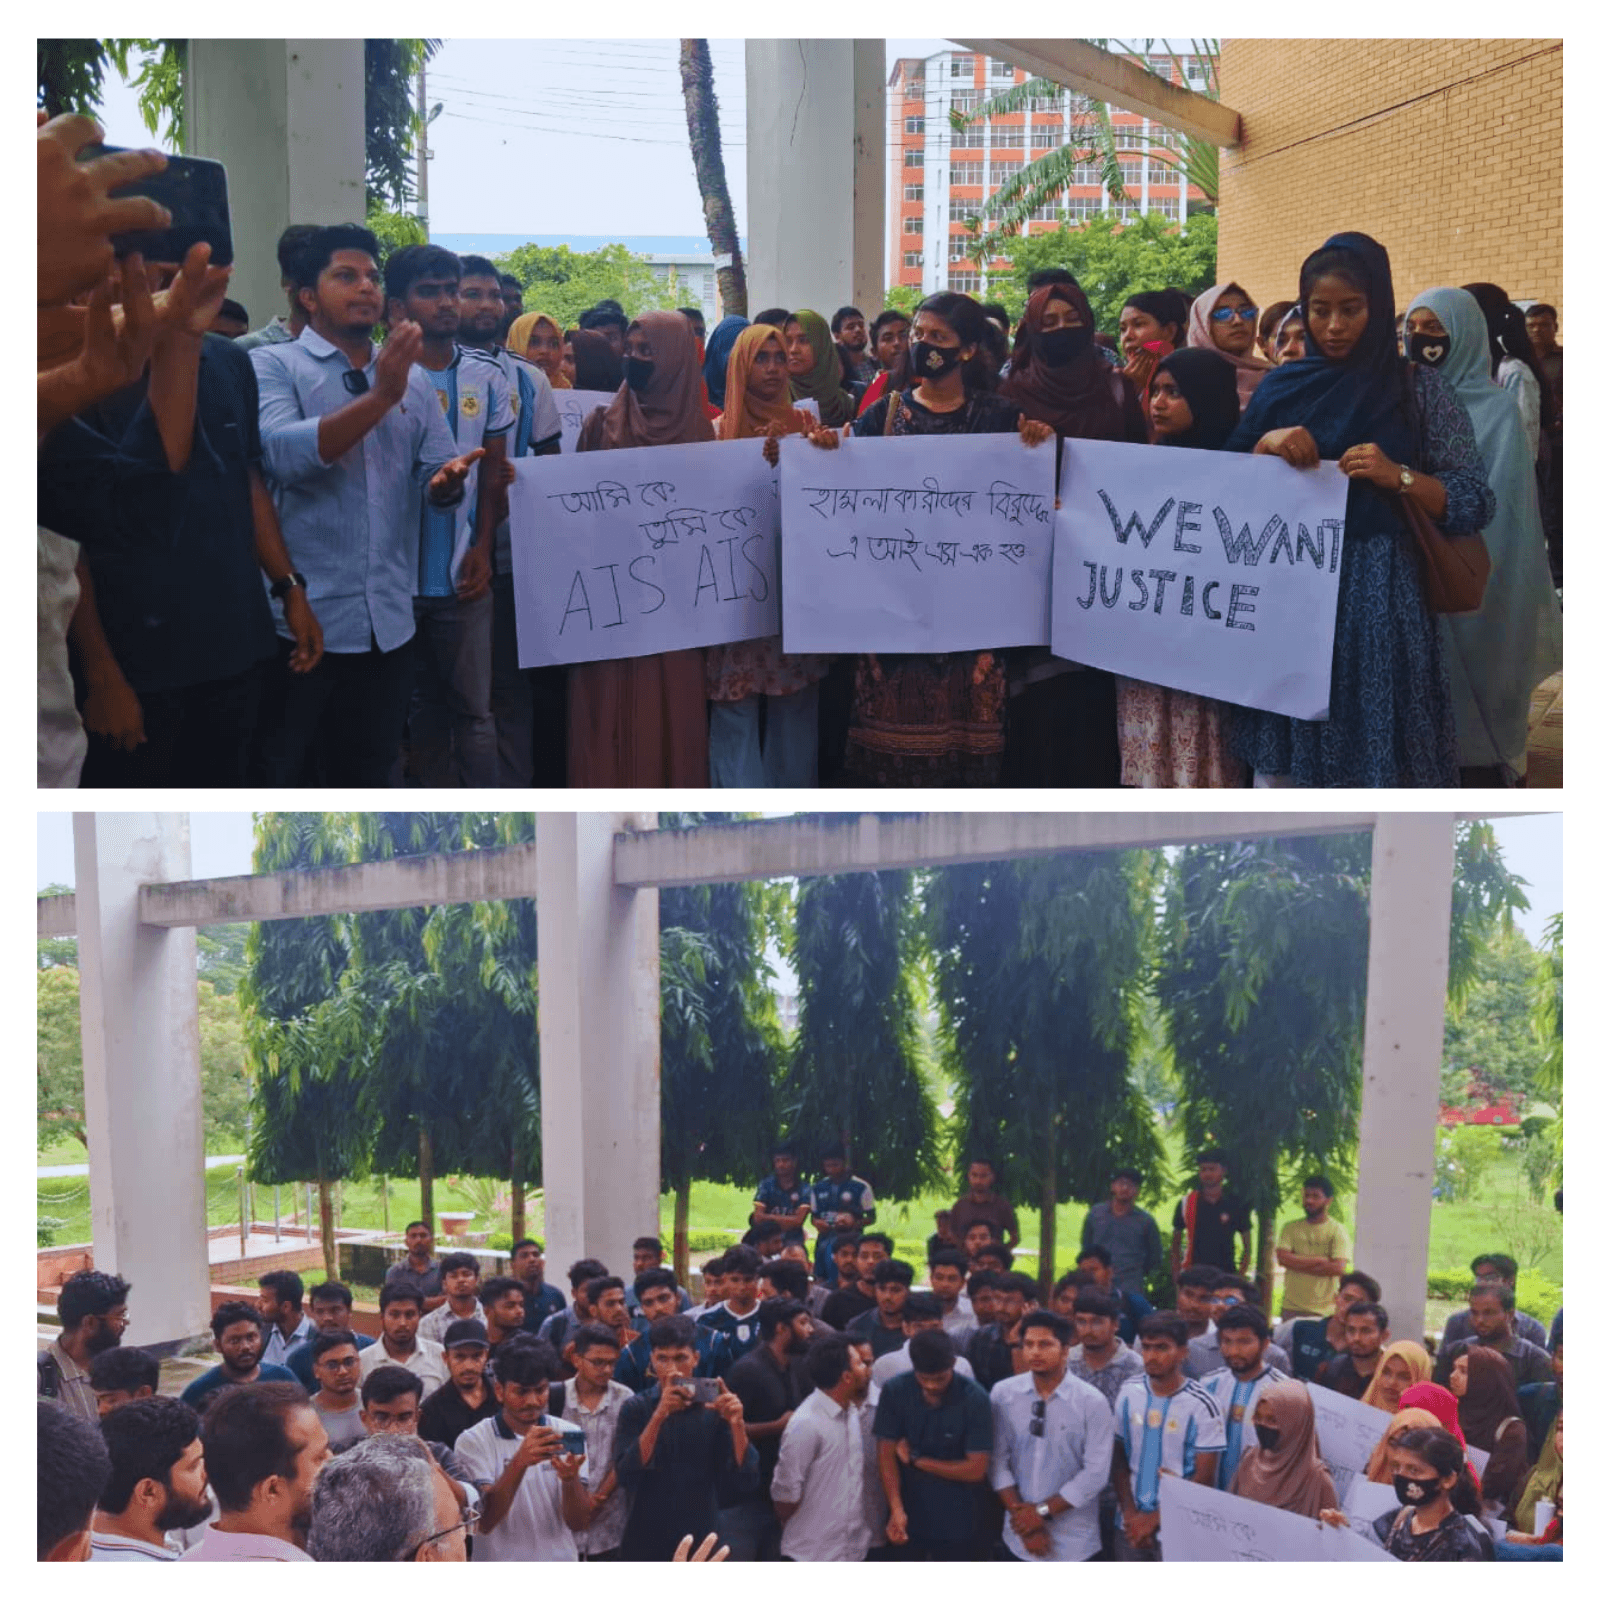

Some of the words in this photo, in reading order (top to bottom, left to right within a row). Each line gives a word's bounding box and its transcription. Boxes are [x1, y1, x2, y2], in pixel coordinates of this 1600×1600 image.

[547, 480, 631, 513] আমি
[638, 507, 708, 550] তুমি
[711, 506, 757, 531] কে
[1097, 488, 1203, 555] WE
[1212, 501, 1346, 574] WANT
[558, 554, 666, 636] AIS
[694, 534, 769, 608] AIS
[1076, 560, 1260, 632] JUSTICE
